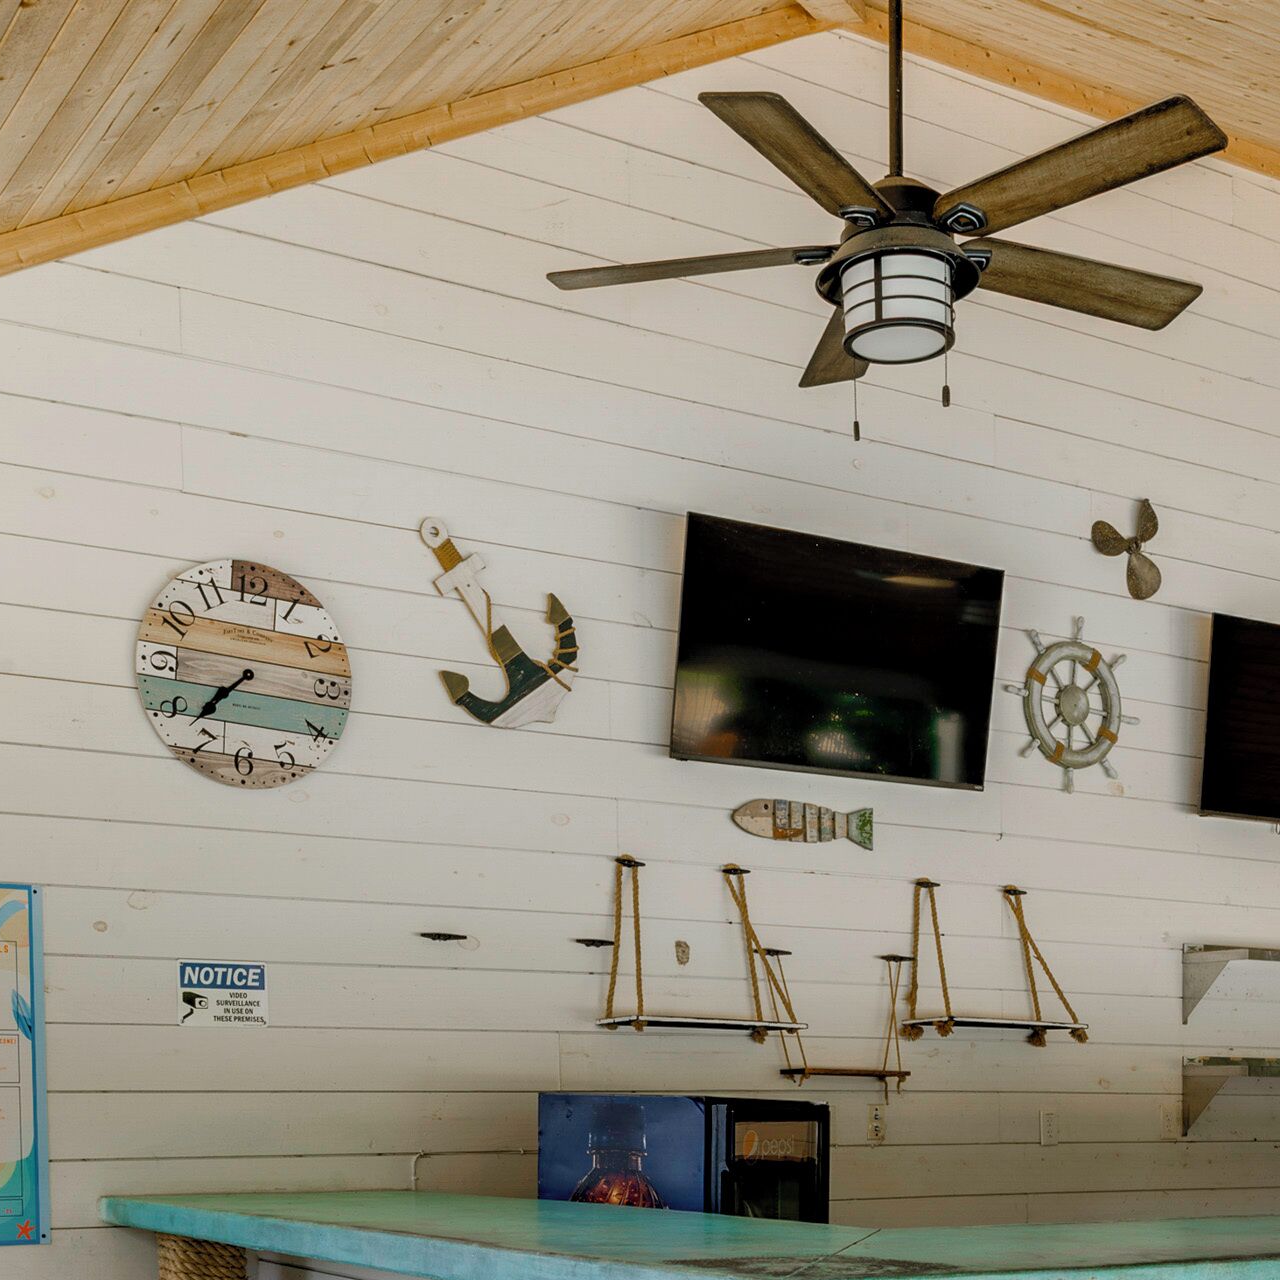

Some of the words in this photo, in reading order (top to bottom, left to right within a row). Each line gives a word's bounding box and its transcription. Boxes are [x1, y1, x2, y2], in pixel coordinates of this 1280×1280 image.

[194, 576, 228, 612] 11
[237, 574, 269, 606] 12
[161, 600, 196, 641] 10
[304, 633, 332, 659] 2
[149, 650, 178, 672] 9
[313, 678, 341, 700] 3
[159, 696, 188, 719] 8
[196, 727, 218, 754] 7
[304, 718, 330, 744] 4
[234, 746, 254, 776] 6
[274, 740, 295, 770] 5
[184, 966, 261, 986] NOTICE
[762, 1135, 794, 1159] pepsi
